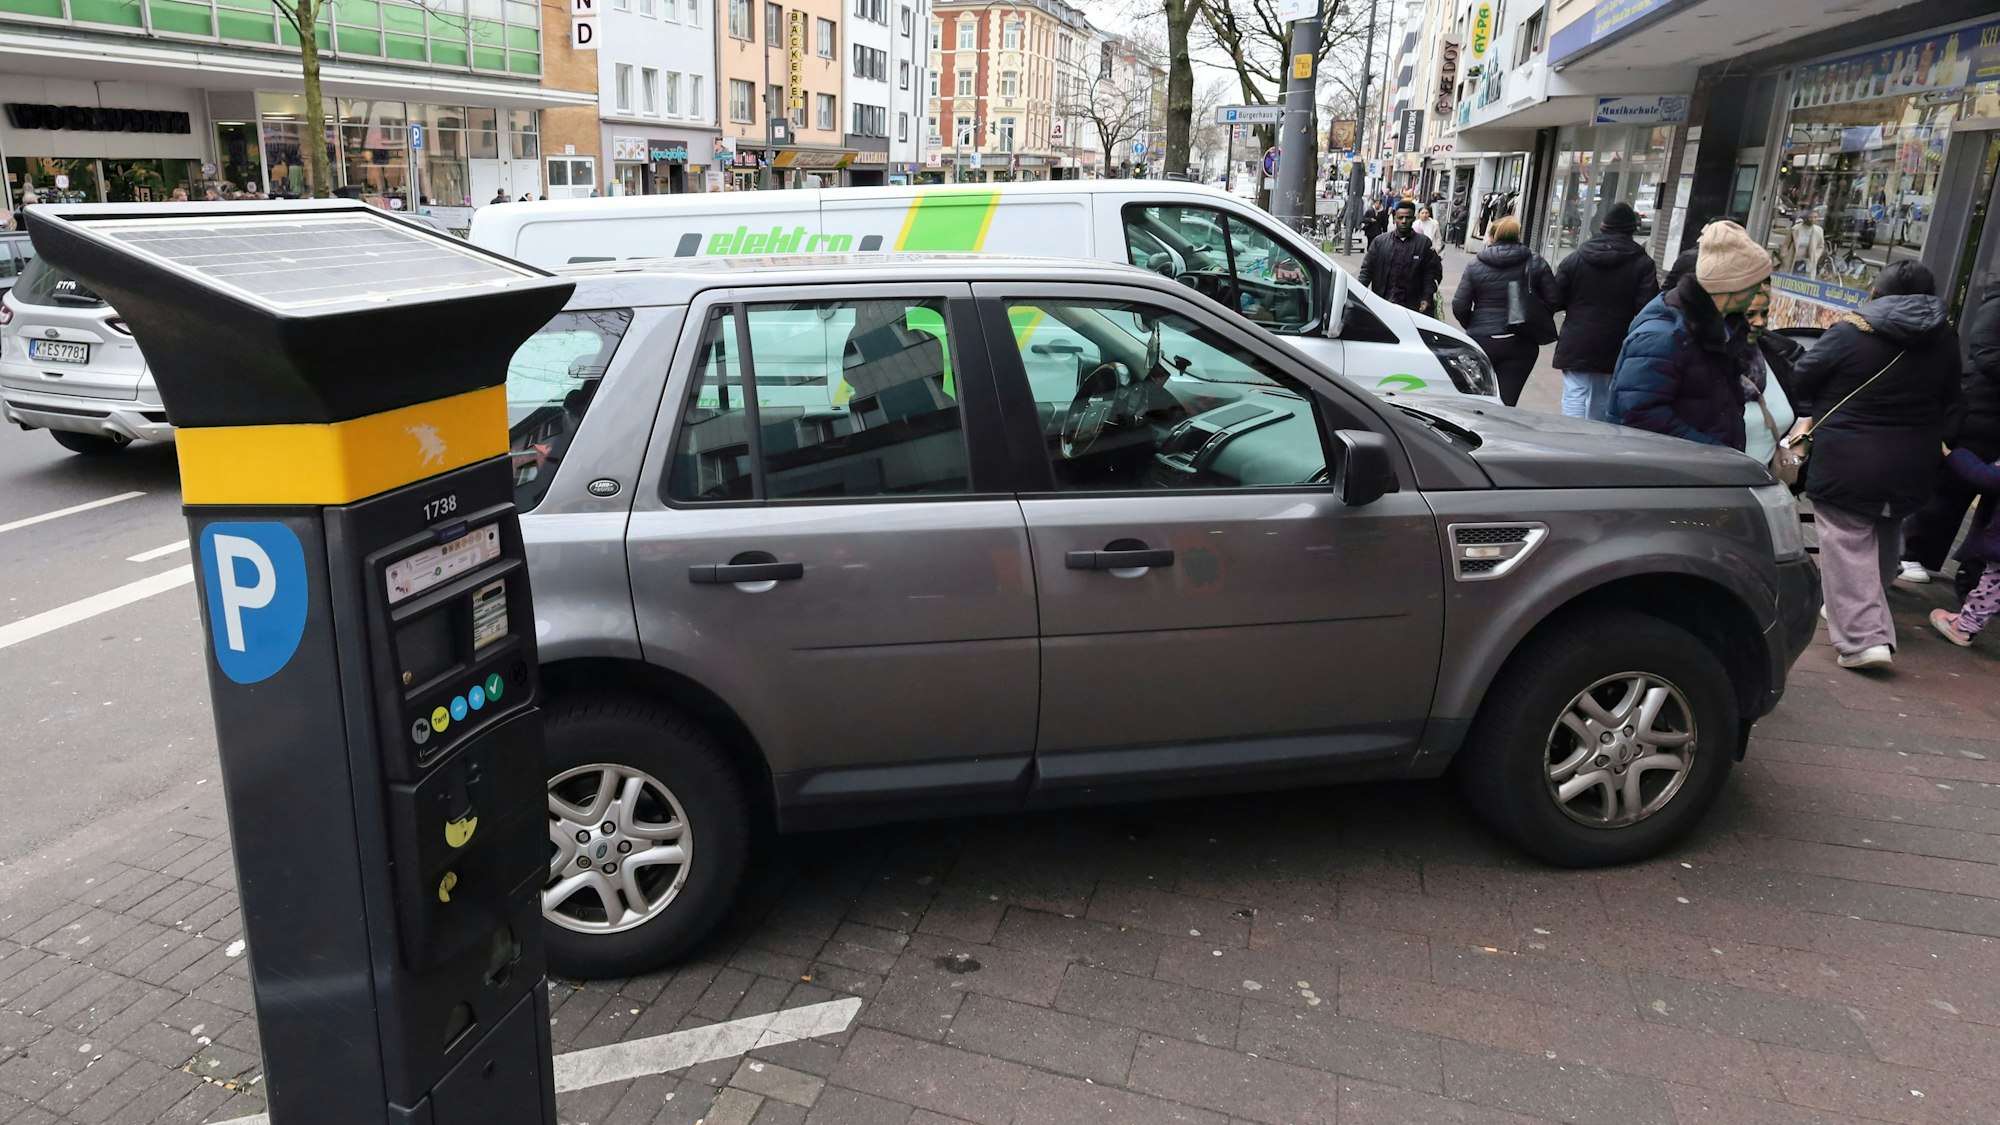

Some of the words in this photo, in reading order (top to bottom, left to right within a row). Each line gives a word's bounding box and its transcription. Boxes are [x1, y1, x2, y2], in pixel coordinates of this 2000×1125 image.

[1475, 8, 1490, 54] AY-PA
[1981, 26, 2000, 48] KH
[1443, 41, 1460, 74] DOY
[1239, 111, 1273, 120] Bürgerhaus
[1600, 105, 1660, 115] Musikschule
[423, 494, 457, 521] 1738
[213, 533, 277, 652] P
[434, 713, 447, 726] Tarif
